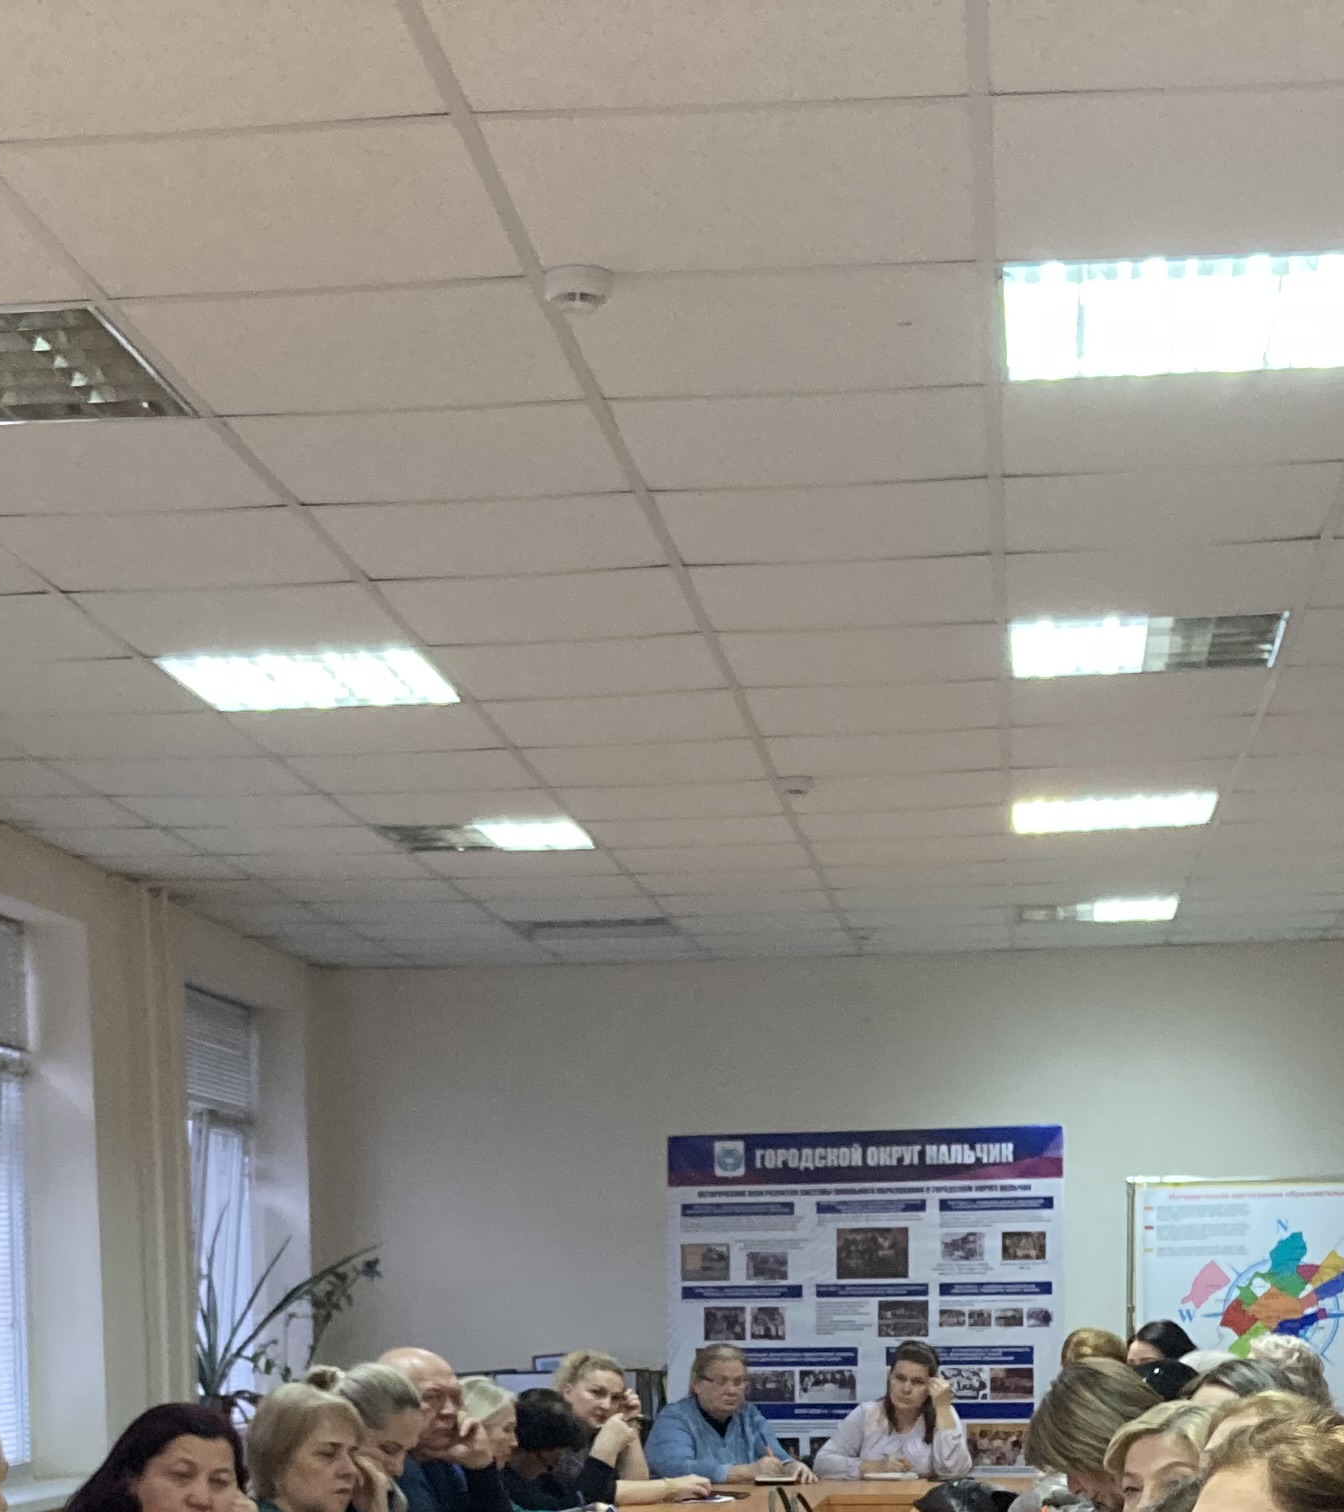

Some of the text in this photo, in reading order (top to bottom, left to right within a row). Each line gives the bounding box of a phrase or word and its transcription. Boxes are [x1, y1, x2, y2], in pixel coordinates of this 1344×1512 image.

[755, 1142, 1014, 1171] ГОРОДСКОЙ ОКРУГ НАЛЬЧИК
[1276, 1218, 1289, 1234] N
[1178, 1308, 1196, 1323] W
